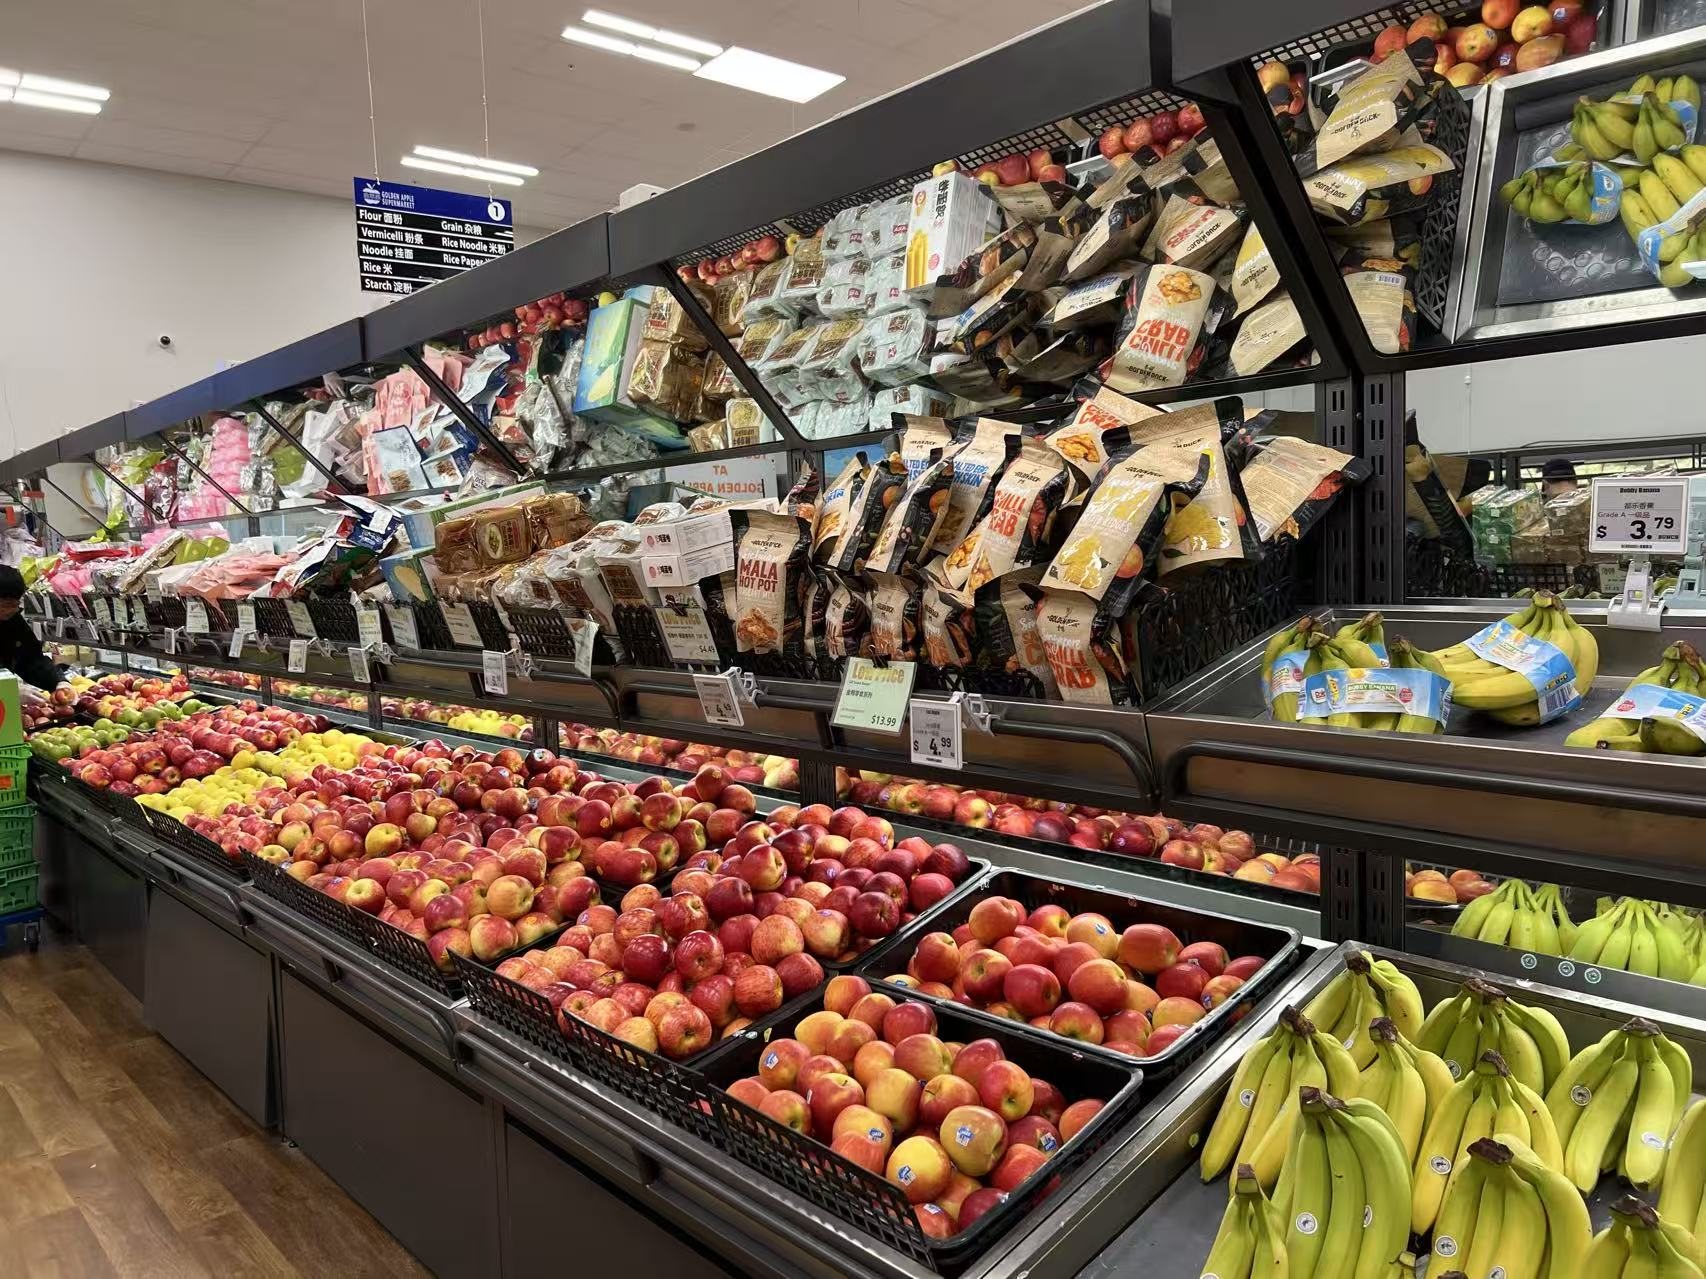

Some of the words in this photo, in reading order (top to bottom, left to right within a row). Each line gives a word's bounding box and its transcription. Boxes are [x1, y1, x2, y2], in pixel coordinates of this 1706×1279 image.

[382, 191, 400, 200] GOLDEN
[401, 194, 414, 202] APPLE
[382, 198, 415, 209] SUPERMARKET
[360, 209, 382, 222] Flour
[493, 205, 499, 217] 1
[441, 221, 463, 232] Grain
[361, 227, 403, 242] Vermicelli
[442, 237, 458, 248] Rice
[459, 240, 488, 251] Noodle
[362, 245, 393, 257] Noodle
[443, 254, 459, 264] Rice
[461, 256, 483, 268] Paper
[364, 262, 381, 272] Rice
[383, 263, 393, 275] 米
[365, 279, 392, 291] Starch
[963, 473, 984, 488] SKIN
[1596, 525, 1607, 538] $
[1654, 517, 1674, 529] 79
[740, 559, 778, 580] MALA
[739, 576, 755, 589] HOT
[758, 579, 778, 592] POT
[871, 715, 897, 727] $13.99
